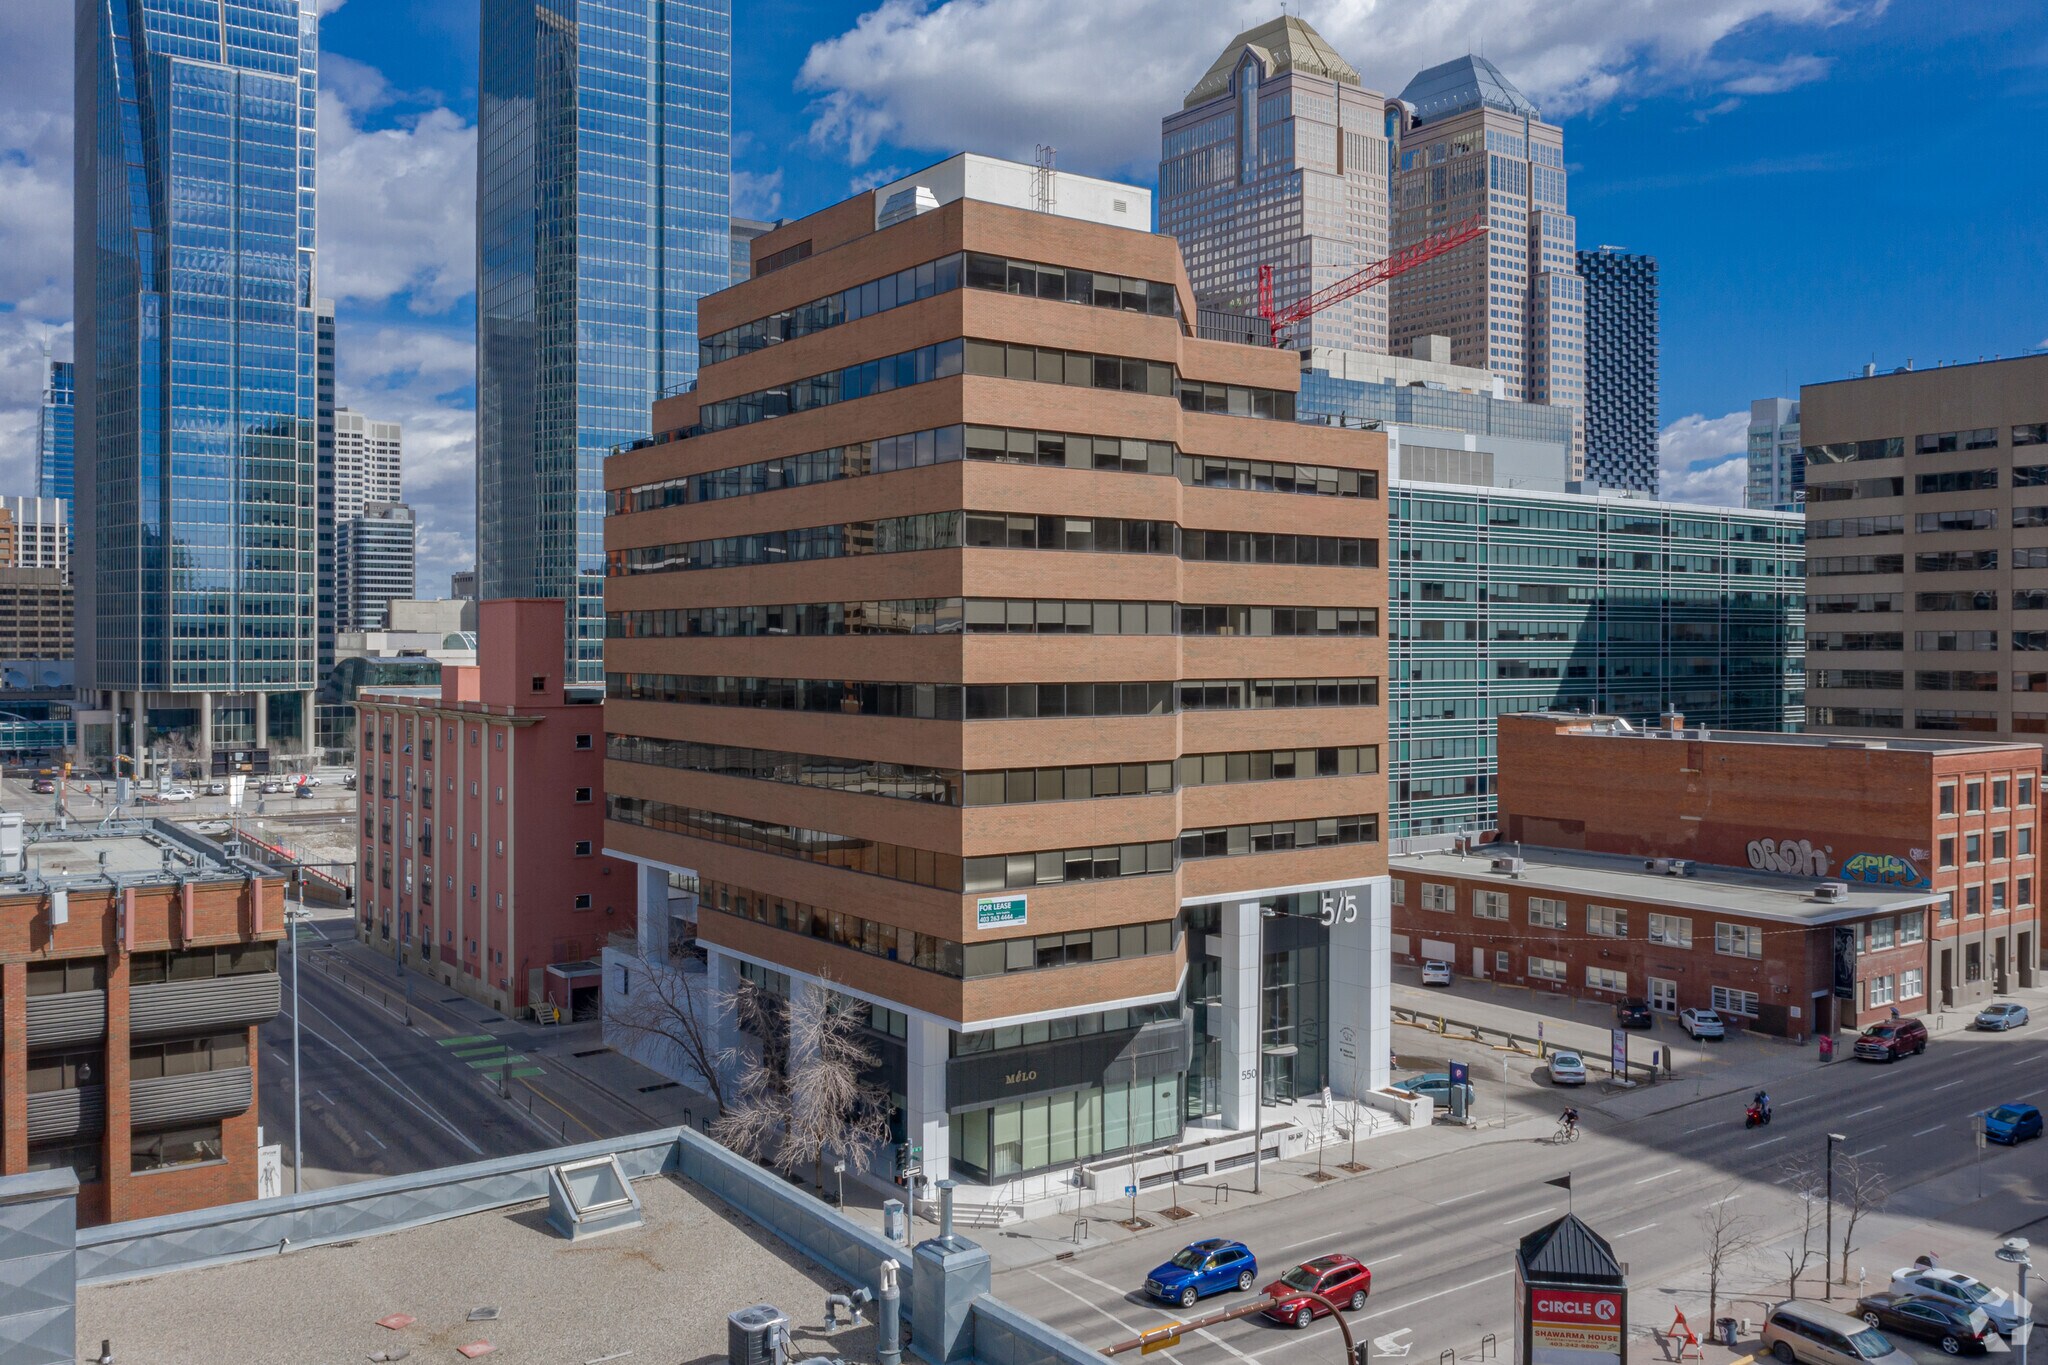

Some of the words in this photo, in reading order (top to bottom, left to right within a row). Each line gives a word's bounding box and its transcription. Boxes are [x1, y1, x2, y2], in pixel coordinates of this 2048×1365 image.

[993, 902, 1012, 910] LEASE
[1320, 895, 1358, 926] 5/5
[1241, 1068, 1257, 1080] 550
[1537, 1300, 1592, 1315] CIRCLE
[1598, 1302, 1615, 1319] K
[1535, 1330, 1585, 1340] SHAWARMA
[1587, 1334, 1618, 1342] HOUSE
